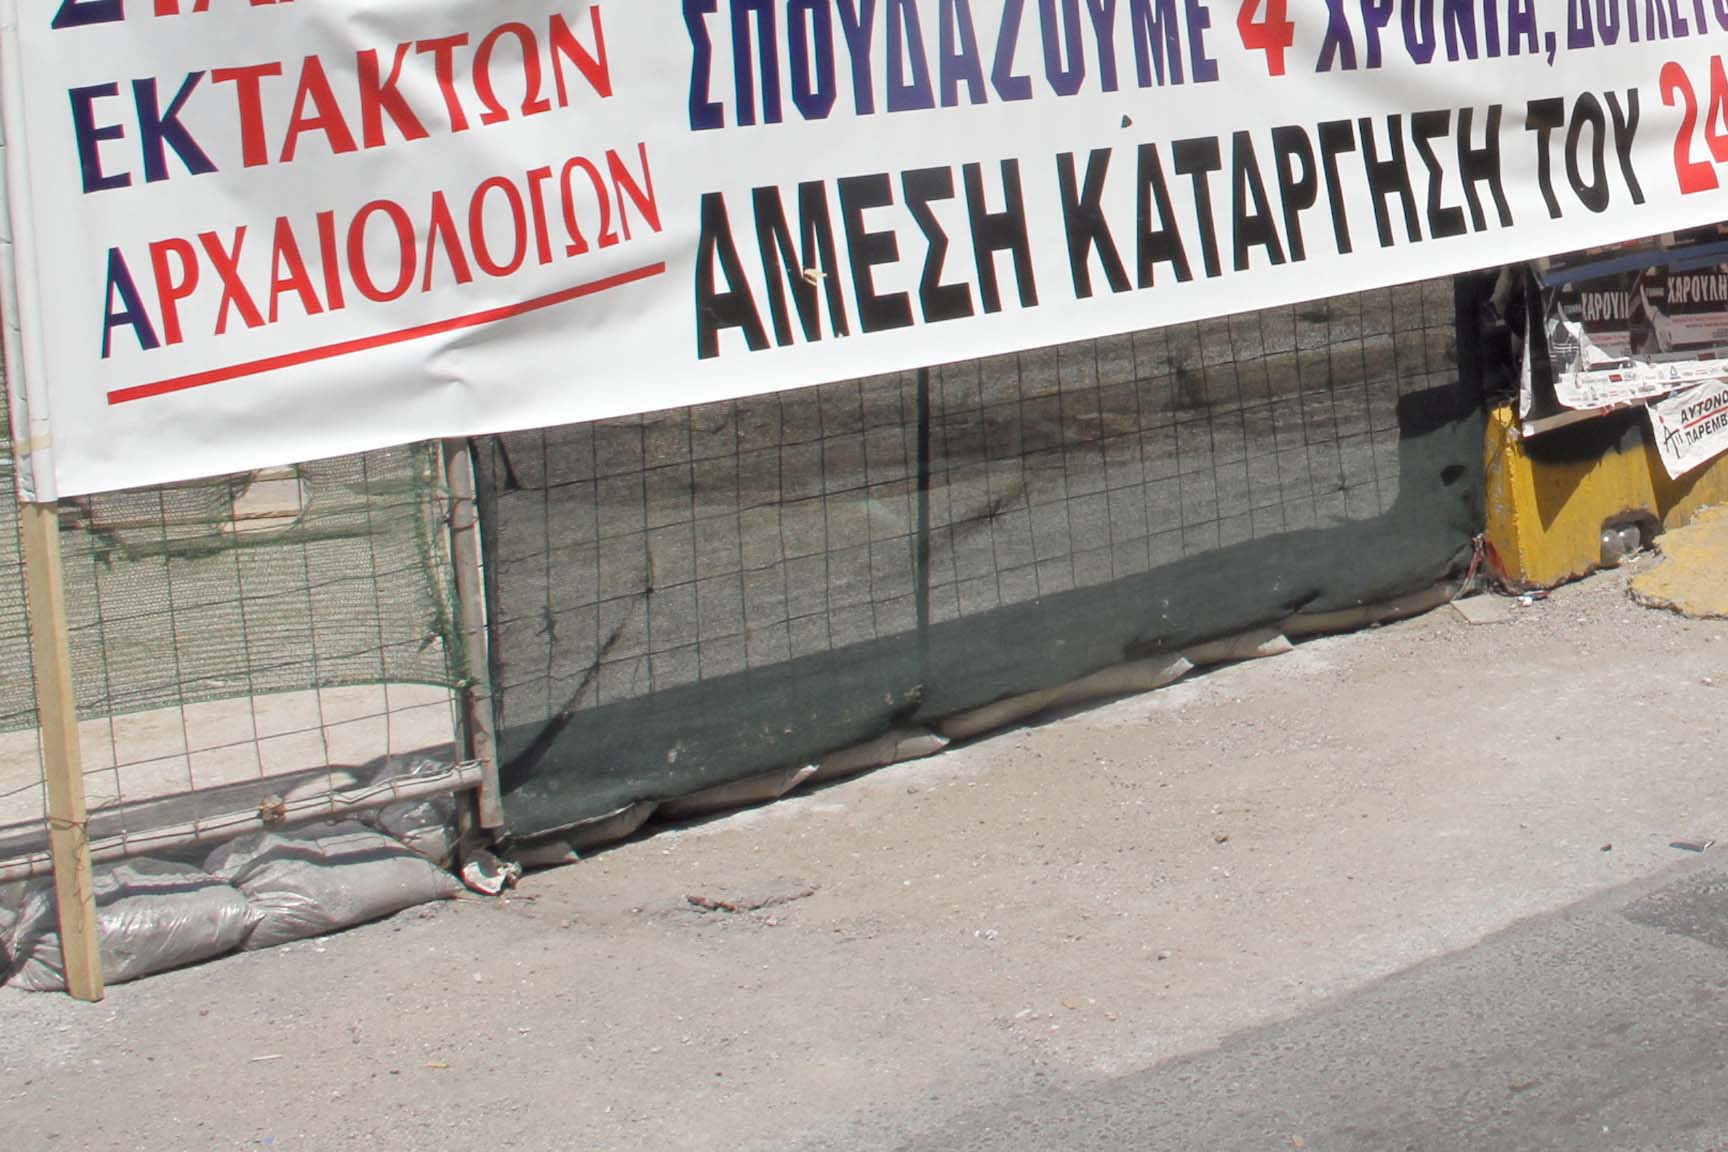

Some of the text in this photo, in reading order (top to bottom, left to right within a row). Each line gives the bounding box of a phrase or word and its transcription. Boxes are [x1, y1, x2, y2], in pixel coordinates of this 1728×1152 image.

[69, 5, 613, 194] ΕΚΤΑΚΤΩΝ
[101, 142, 662, 359] ΑΡΧΑΙΟΛΟΓΩΝ
[695, 158, 1038, 360] ΑΜΕΣΗ
[1056, 103, 1513, 299] ΚΑΤΑΡΓΗΣΗ
[1525, 88, 1645, 219] ΤΟΥ
